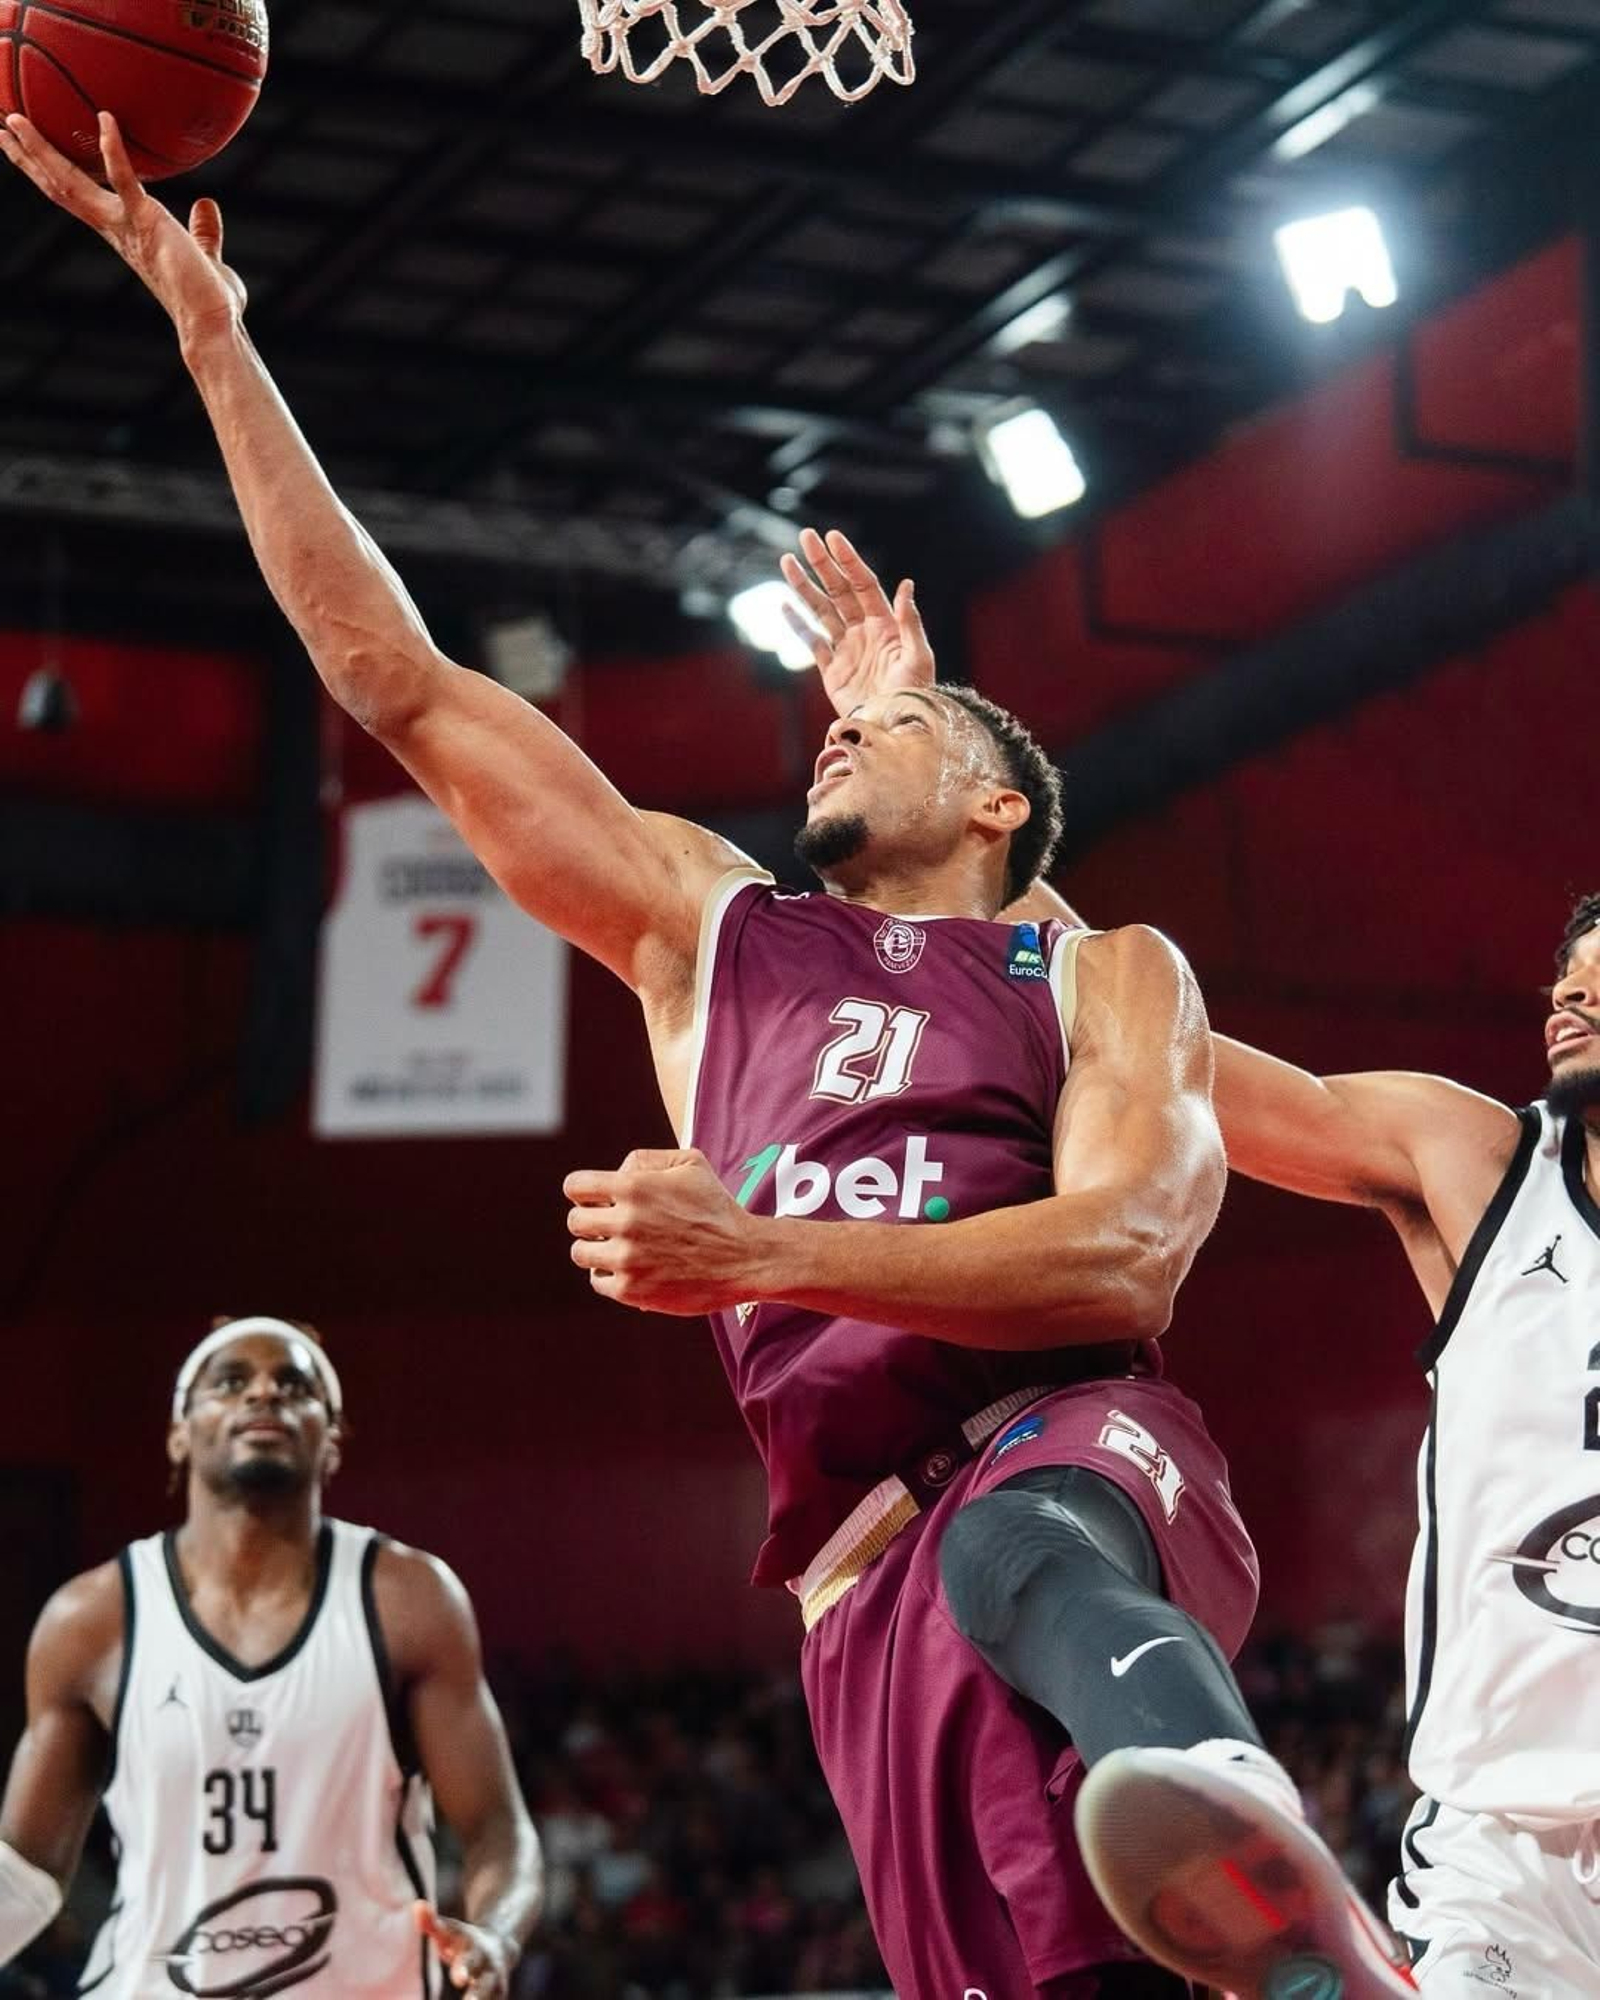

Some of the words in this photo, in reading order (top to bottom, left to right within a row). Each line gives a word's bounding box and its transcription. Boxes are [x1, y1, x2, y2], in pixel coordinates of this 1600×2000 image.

[411, 913, 477, 1009] 7
[809, 997, 930, 1104] 21
[1099, 1409, 1186, 1525] 21
[203, 1769, 277, 1855] 34
